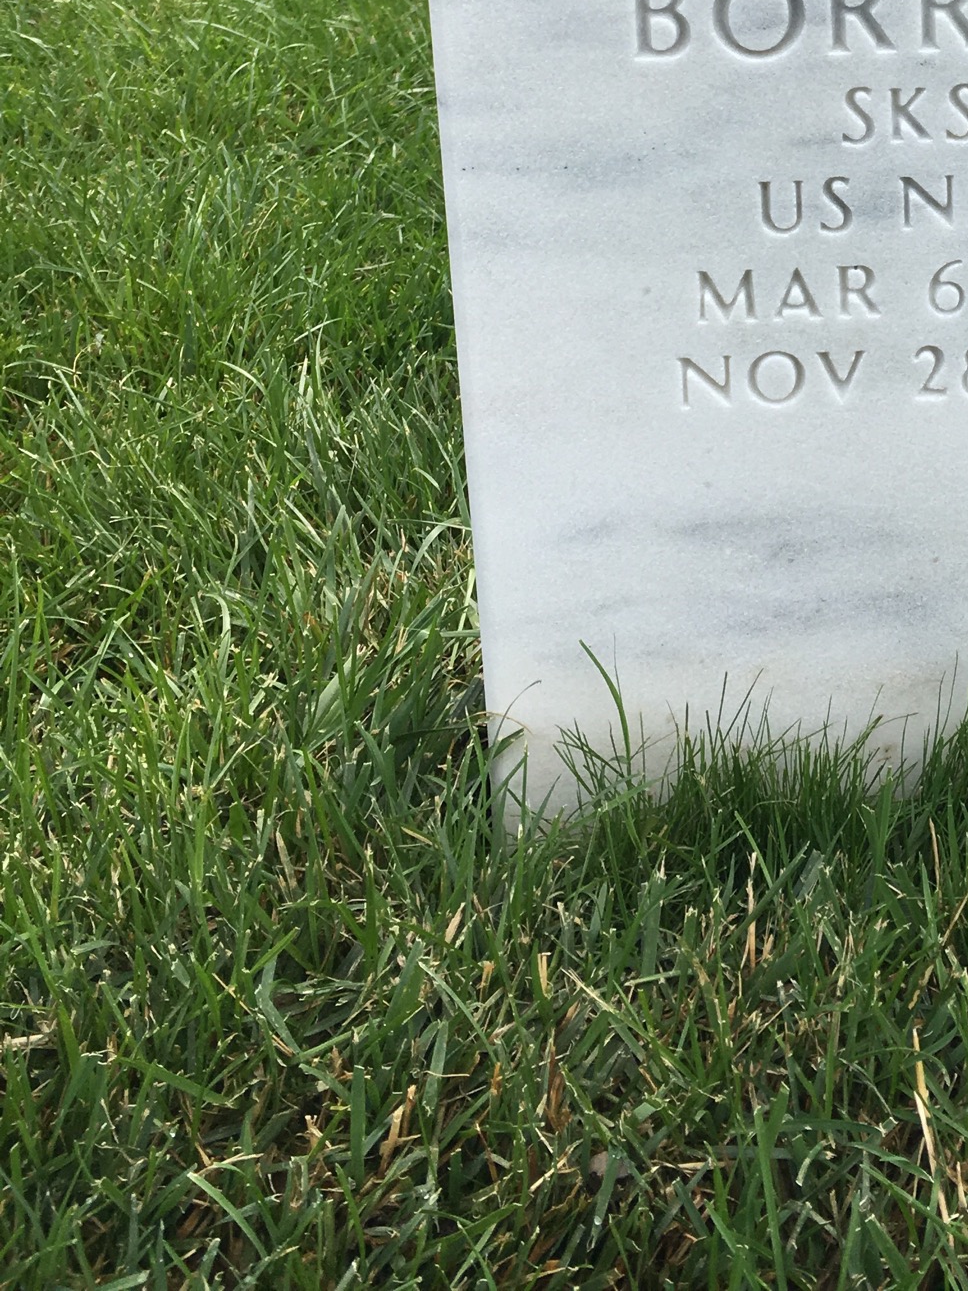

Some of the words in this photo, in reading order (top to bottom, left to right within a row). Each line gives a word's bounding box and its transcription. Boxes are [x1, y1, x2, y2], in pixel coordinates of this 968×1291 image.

[759, 176, 855, 235] US
[697, 264, 883, 324] MAR
[928, 259, 967, 315] 6
[677, 350, 866, 410] NOV
